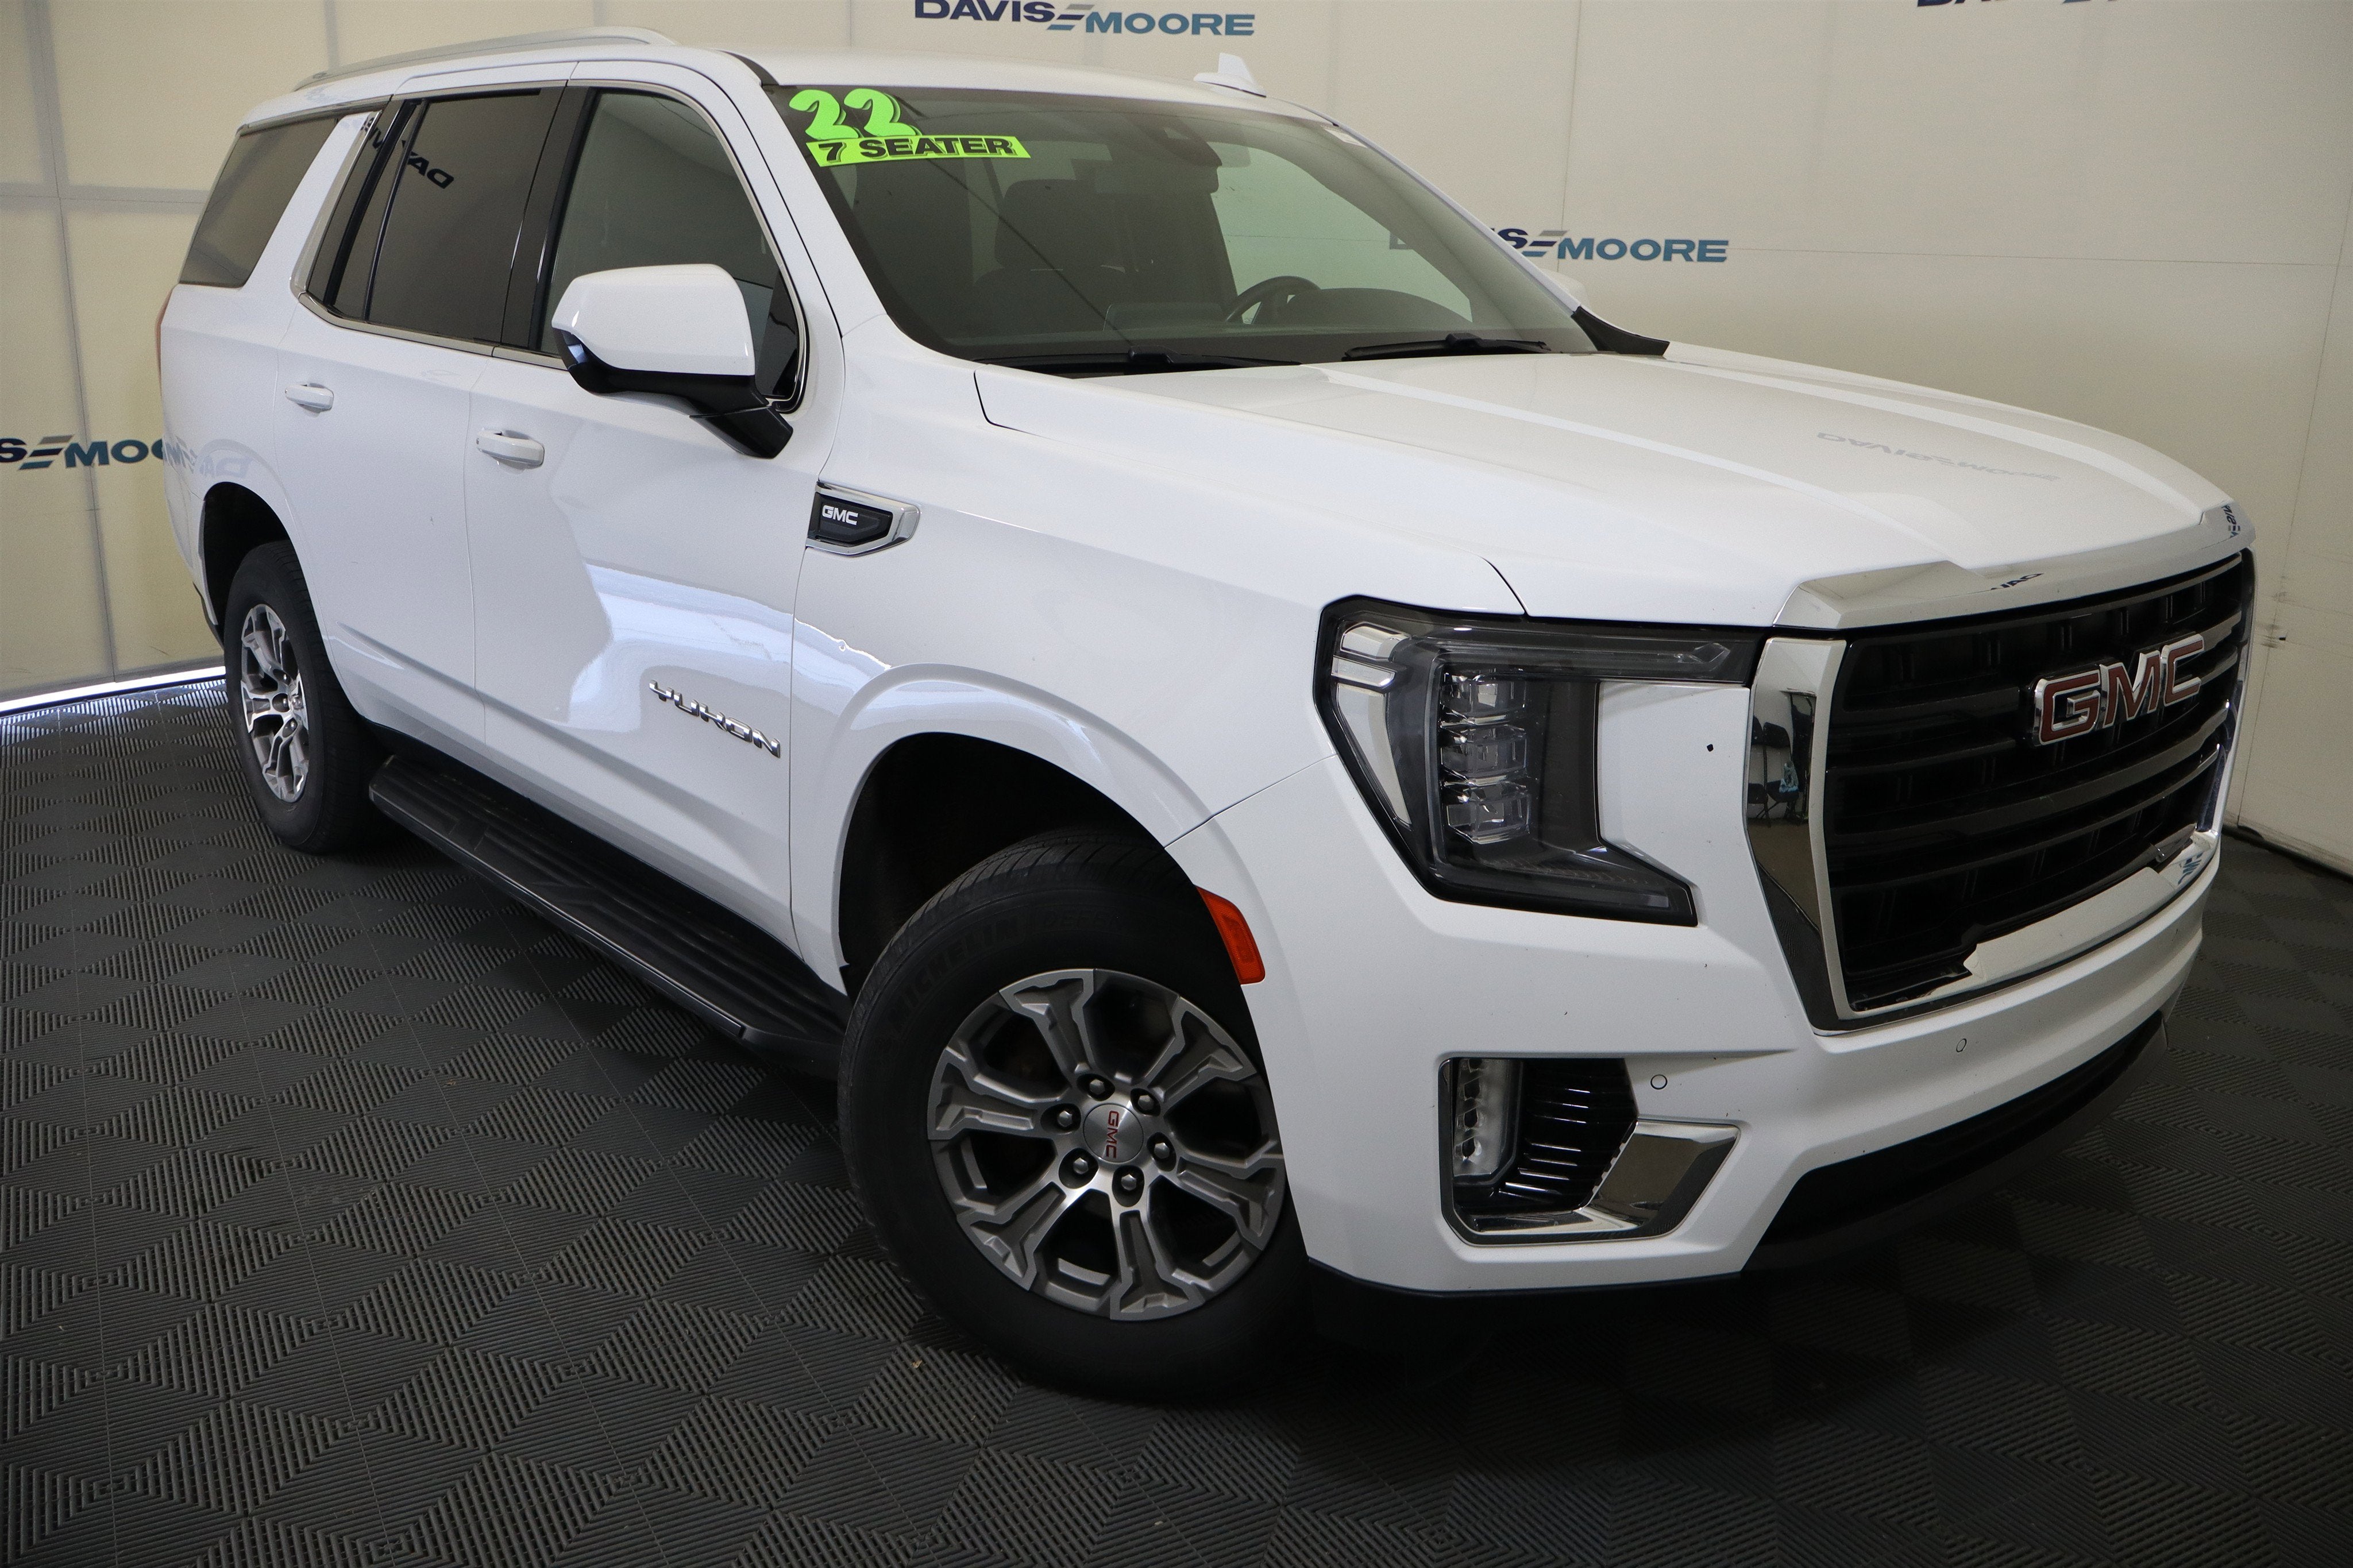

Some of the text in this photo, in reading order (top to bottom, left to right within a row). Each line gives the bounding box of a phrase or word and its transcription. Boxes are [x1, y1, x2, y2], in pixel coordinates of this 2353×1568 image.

[915, 0, 1256, 36] DAVIS MOORE
[789, 88, 923, 140] 22
[818, 138, 1018, 163] 7 SEATER
[1557, 237, 1729, 262] MOORE
[821, 504, 859, 526] GMC
[2034, 633, 2205, 746] GMC
[649, 679, 781, 758] YUKON
[1105, 1110, 1120, 1158] GMC
